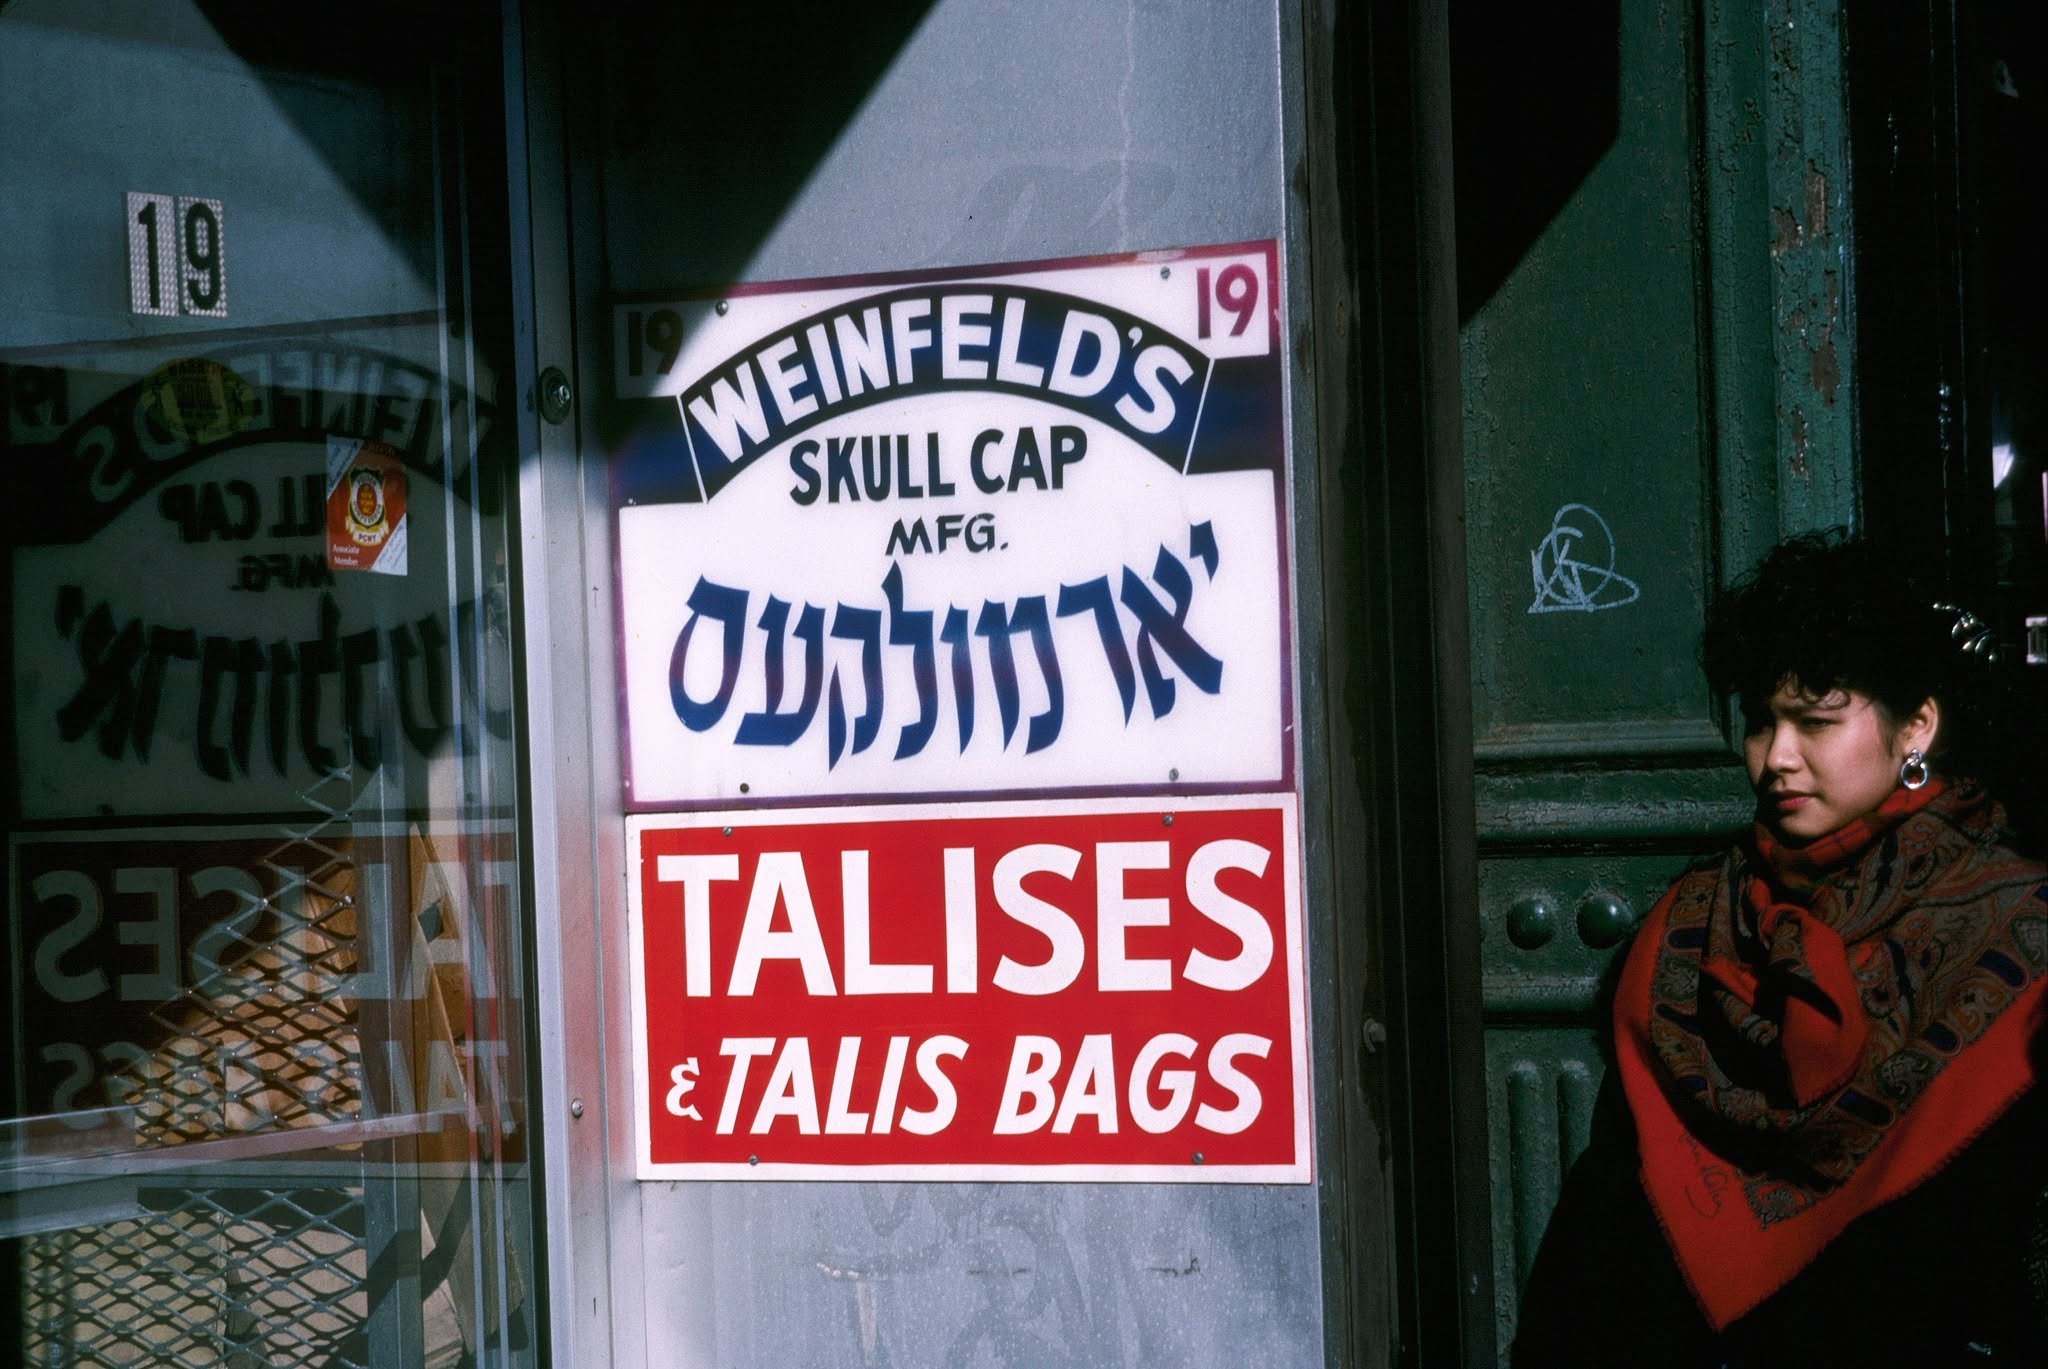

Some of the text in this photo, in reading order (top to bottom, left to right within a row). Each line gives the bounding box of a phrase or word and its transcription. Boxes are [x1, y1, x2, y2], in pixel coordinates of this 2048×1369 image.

[137, 201, 221, 311] 19
[1195, 264, 1259, 341] 19
[627, 309, 684, 377] 19
[688, 294, 1193, 464] WEINFELD'S
[787, 425, 1088, 506] SKULL CAP
[885, 512, 1010, 557] MFG.
[668, 519, 1223, 773] יארמולקעס
[657, 838, 1275, 998] TALISES
[715, 1034, 970, 1136] TALIS
[993, 1033, 1273, 1135] BAGS
